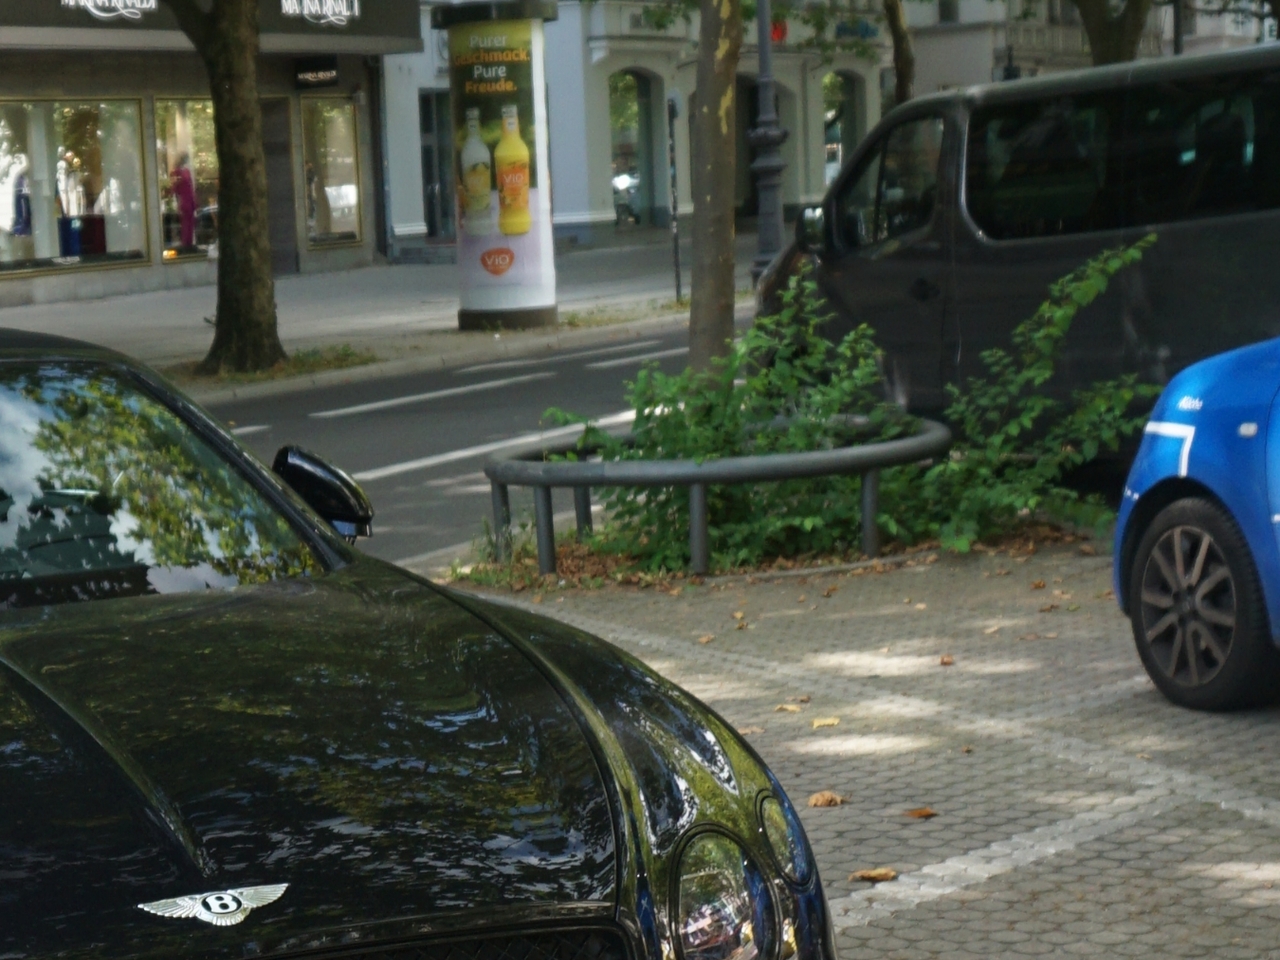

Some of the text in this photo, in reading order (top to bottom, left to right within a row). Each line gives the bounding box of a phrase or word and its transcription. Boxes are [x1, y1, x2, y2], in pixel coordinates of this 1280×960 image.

[470, 35, 507, 48] Purer
[473, 65, 507, 78] Pure
[465, 78, 518, 93] Freude.
